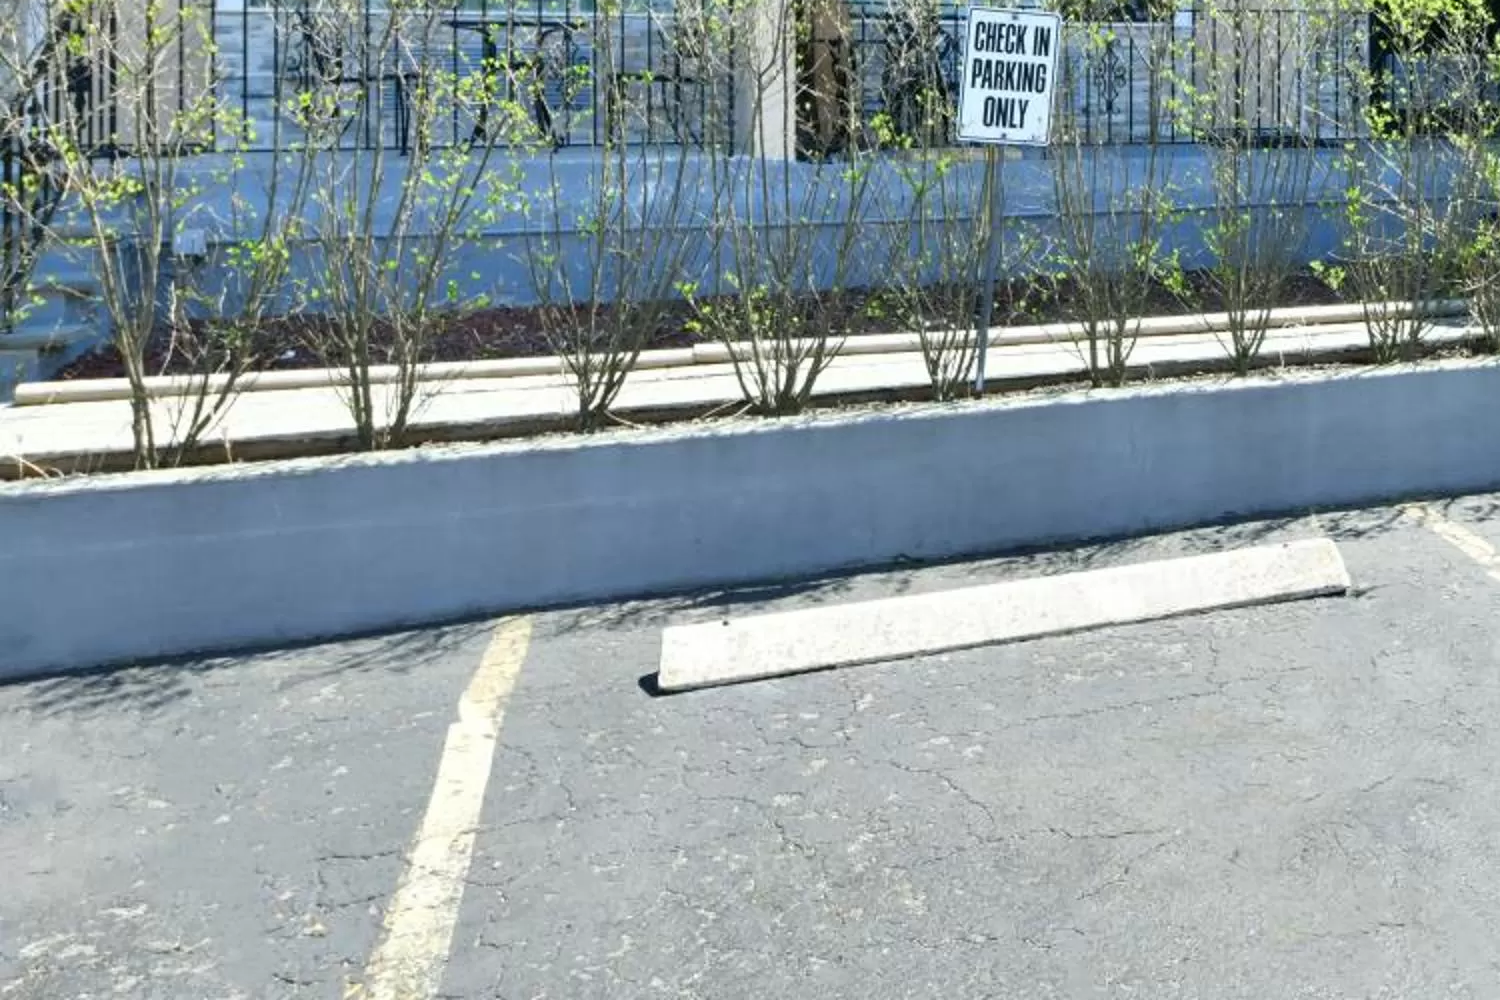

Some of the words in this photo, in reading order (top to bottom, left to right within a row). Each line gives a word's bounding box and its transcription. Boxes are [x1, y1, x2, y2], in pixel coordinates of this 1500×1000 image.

[974, 21, 1028, 55] CHECK
[1033, 26, 1051, 57] IN
[971, 58, 1047, 93] PARKING
[982, 96, 1029, 129] ONLY
